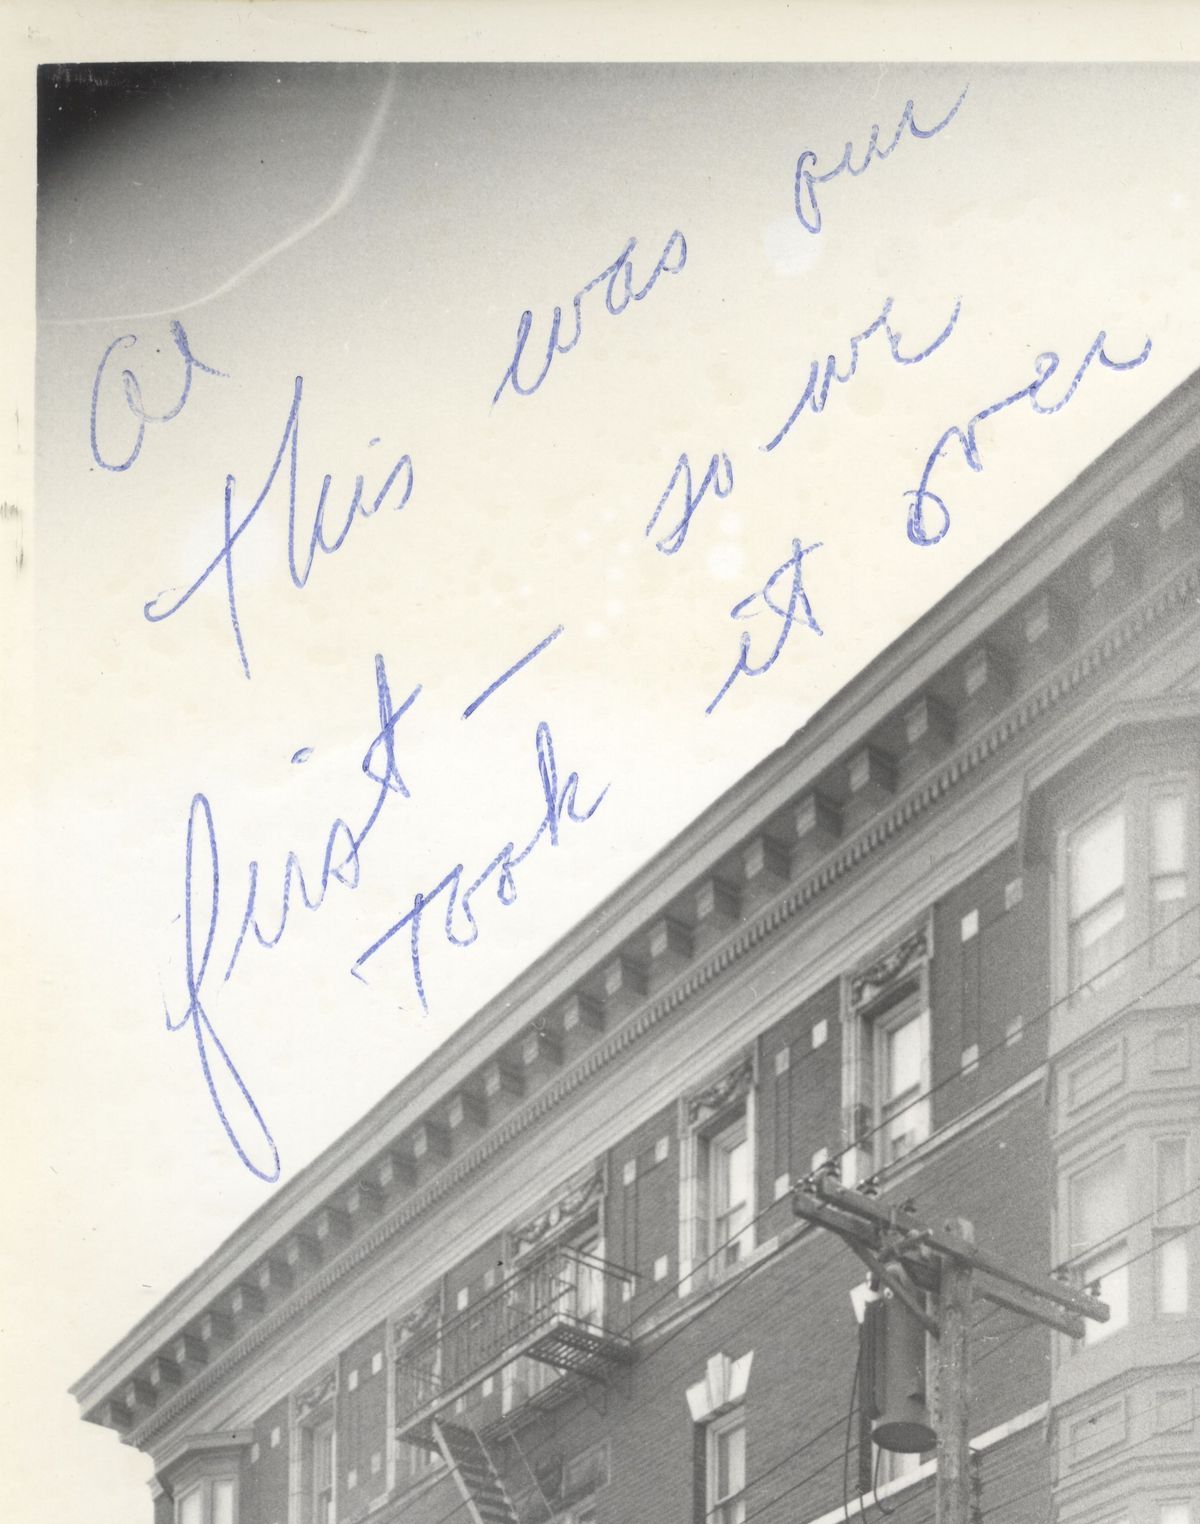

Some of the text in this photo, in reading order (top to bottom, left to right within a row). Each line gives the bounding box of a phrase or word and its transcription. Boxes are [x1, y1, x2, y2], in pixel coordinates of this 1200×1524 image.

[490, 229, 688, 410] was
[794, 83, 968, 235] our
[706, 541, 823, 716] it
[905, 331, 1154, 548] over
[164, 652, 422, 1184] first
[646, 452, 736, 556] so
[766, 297, 963, 453] we
